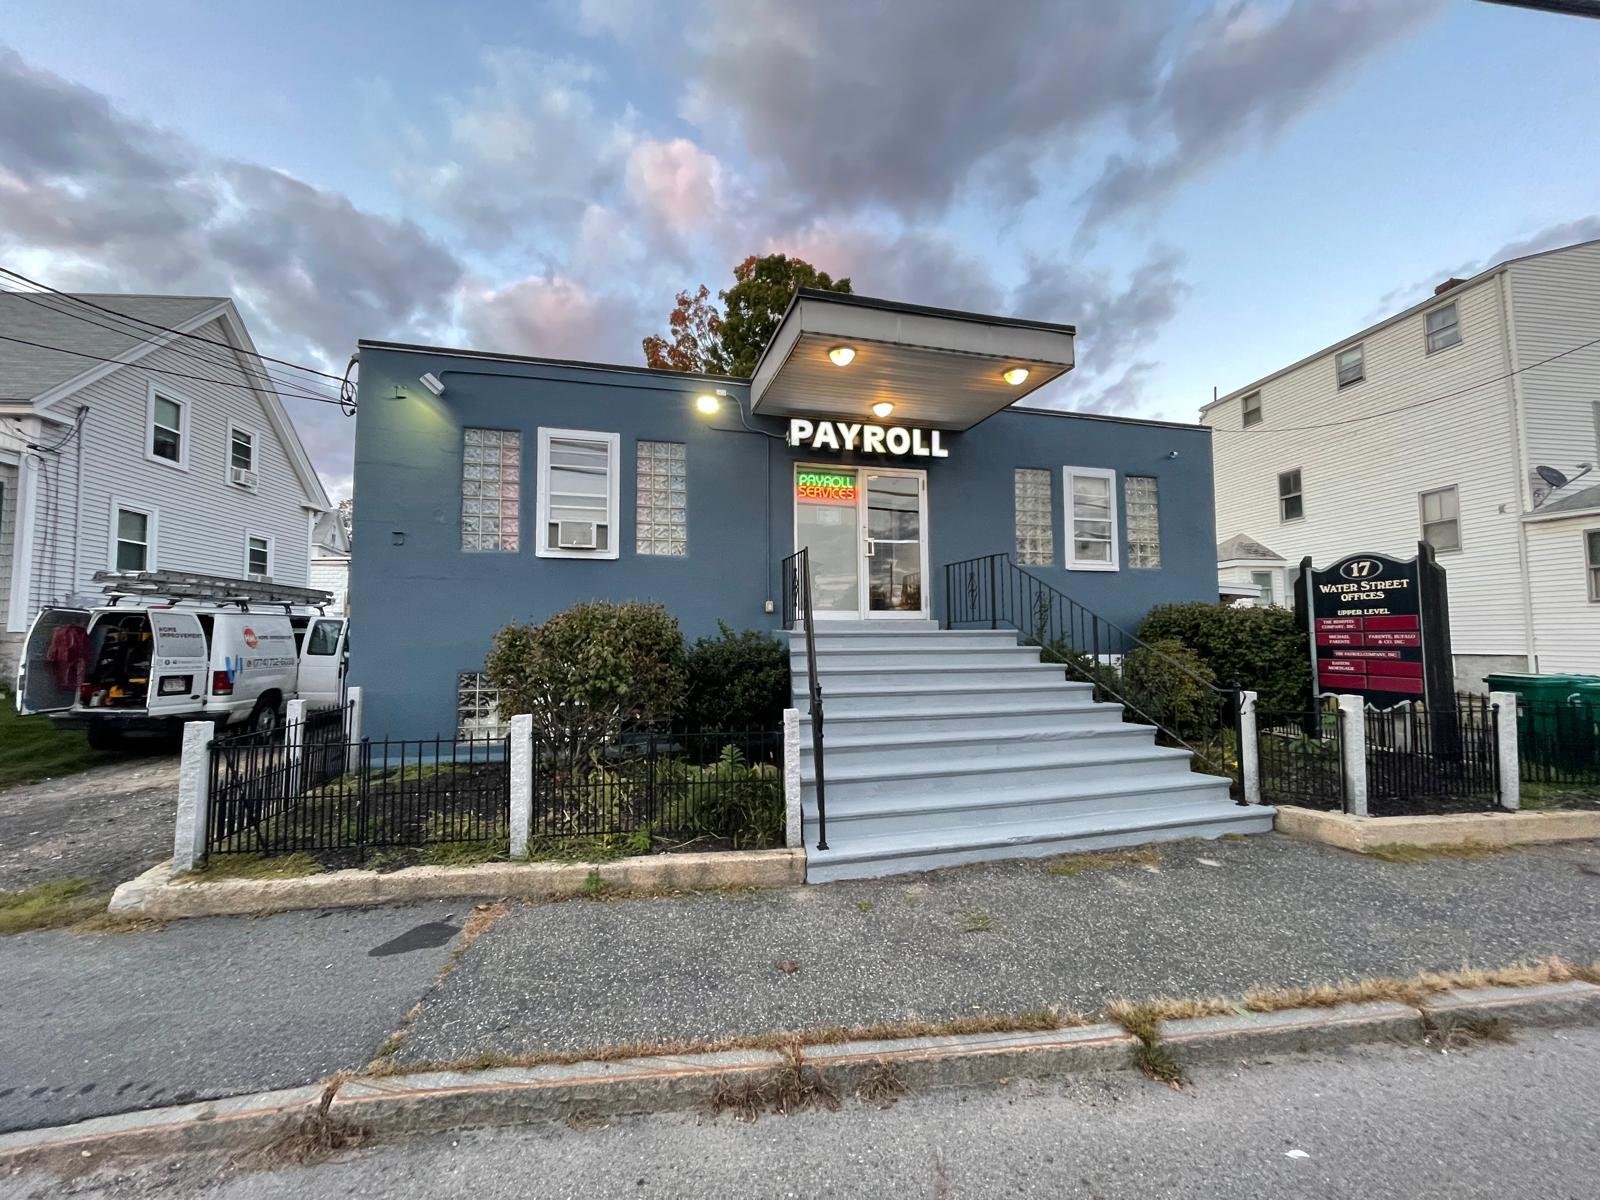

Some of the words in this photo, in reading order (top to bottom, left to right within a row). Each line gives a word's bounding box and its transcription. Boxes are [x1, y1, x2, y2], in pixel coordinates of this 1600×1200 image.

[789, 418, 949, 457] PAYROLL
[798, 474, 854, 488] PAYROLL
[798, 486, 855, 500] SERVICES
[1350, 561, 1371, 577] 17
[1319, 583, 1358, 593] WATER
[1360, 579, 1410, 591] STREET
[1341, 591, 1385, 602] OFFICES
